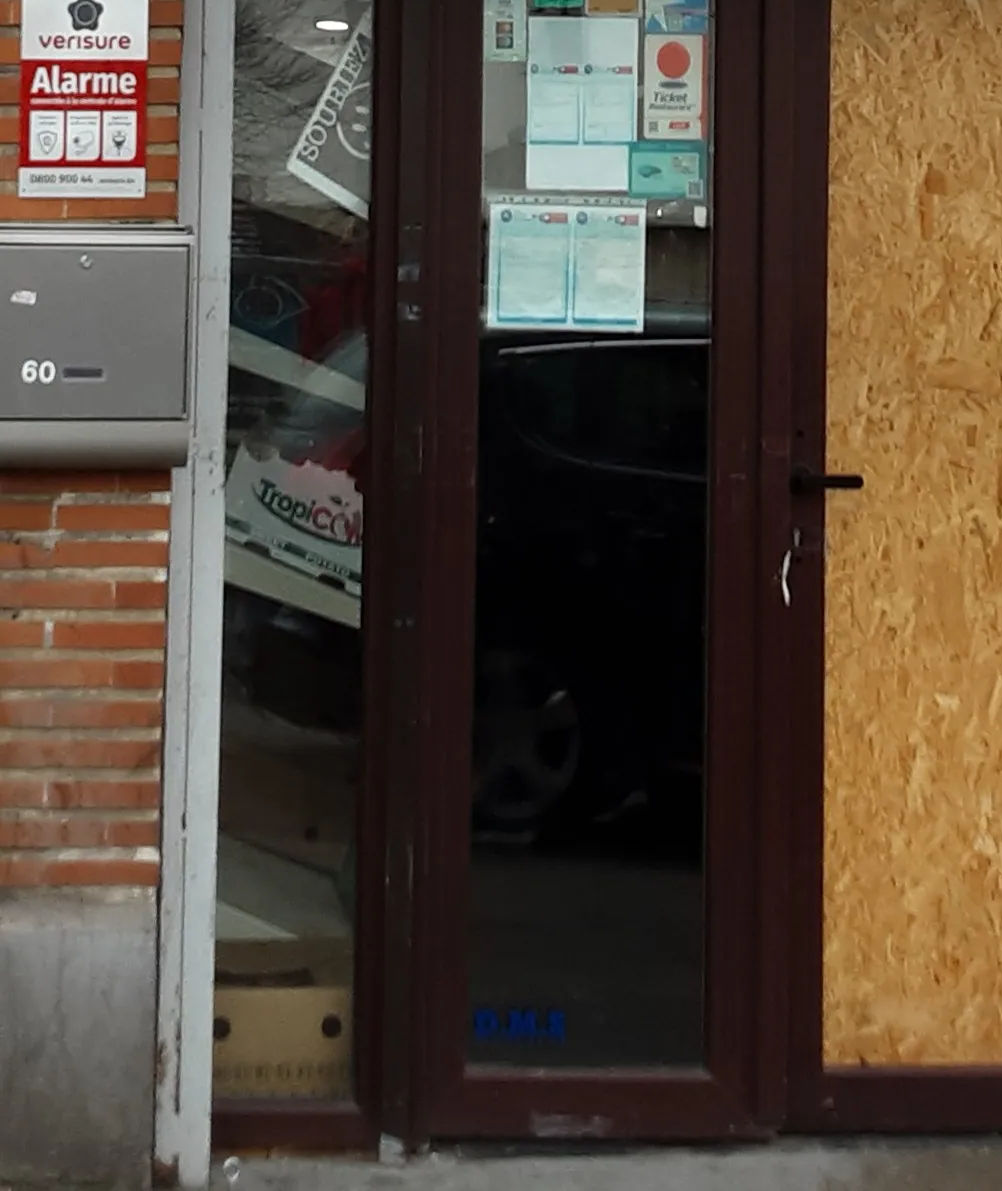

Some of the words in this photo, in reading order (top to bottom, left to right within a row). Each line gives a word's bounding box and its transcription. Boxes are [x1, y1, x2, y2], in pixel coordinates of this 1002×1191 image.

[38, 34, 132, 50] verisure
[30, 66, 137, 96] Alarme
[653, 90, 689, 105] Ticket
[21, 359, 57, 384] 60
